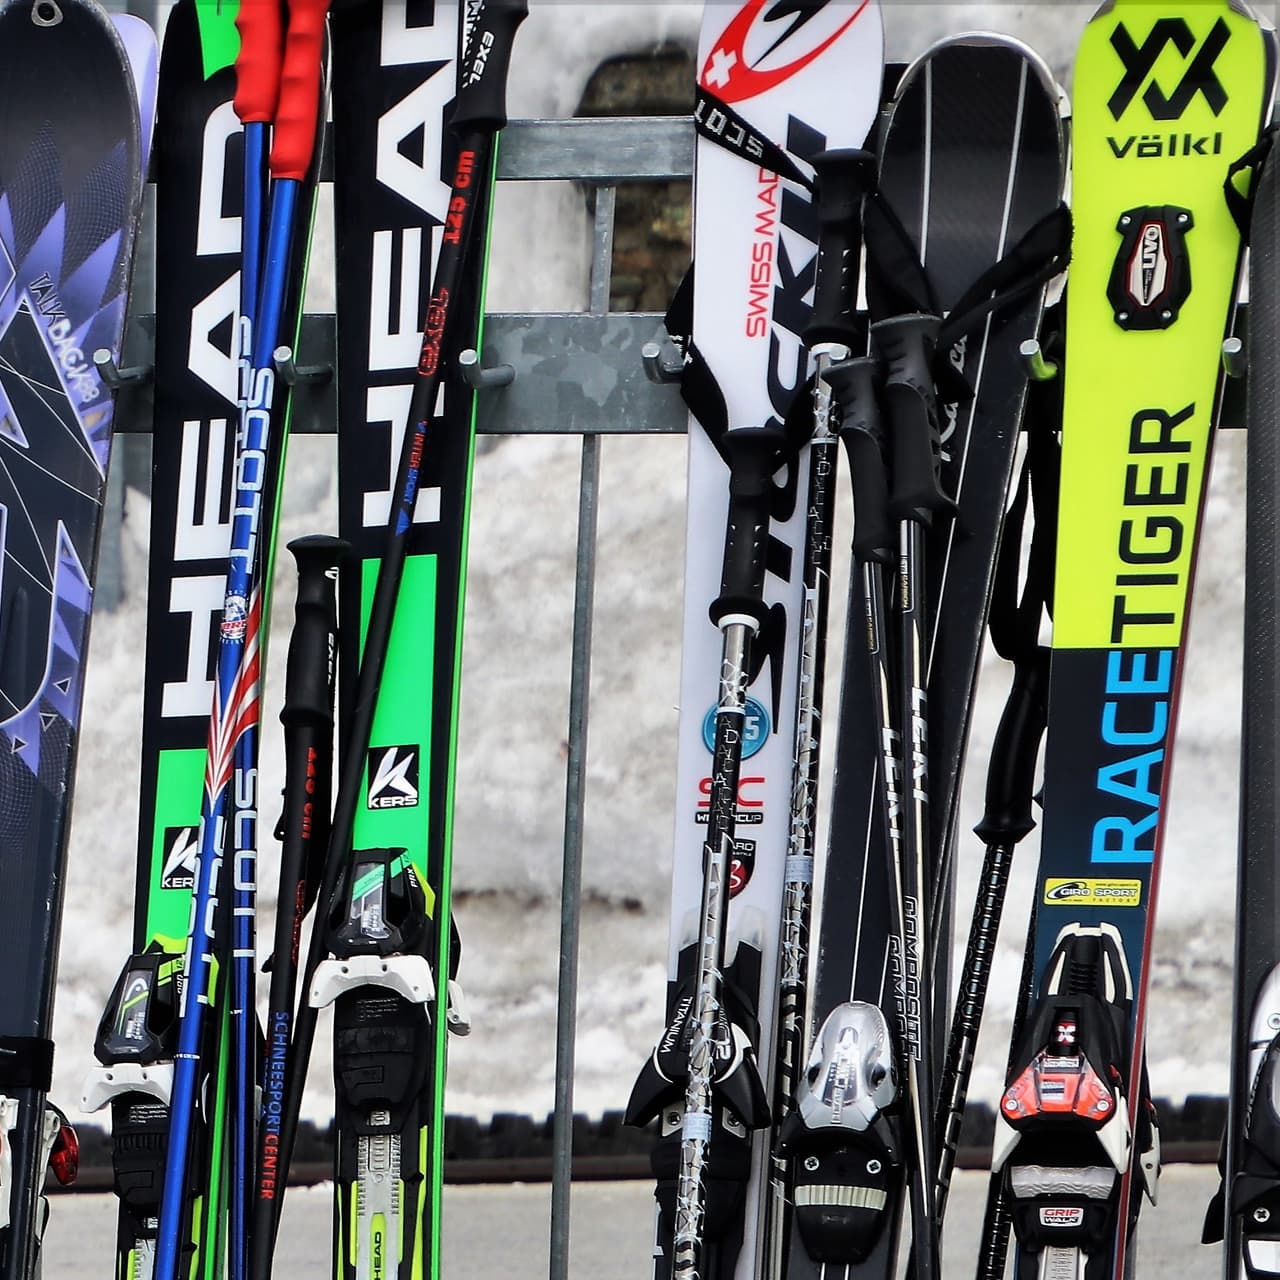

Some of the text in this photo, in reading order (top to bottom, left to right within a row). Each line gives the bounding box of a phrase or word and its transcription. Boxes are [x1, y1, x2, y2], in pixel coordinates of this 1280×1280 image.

[1105, 131, 1223, 158] Völkl
[363, 0, 463, 528] HEA
[746, 147, 780, 338] SWISS MAD
[1142, 226, 1158, 269] UVO
[232, 368, 275, 575] SCOTT
[368, 794, 419, 809] KERS
[162, 876, 194, 889] KER
[1060, 887, 1138, 897] GIRO SPORT
[903, 895, 923, 1063] COMPOSITE
[660, 996, 693, 1054] TITANIUM
[260, 1012, 288, 1200] SCHNEESPORTCENTER
[1044, 1208, 1080, 1216] GRIP
[1044, 1216, 1077, 1224] WALK
